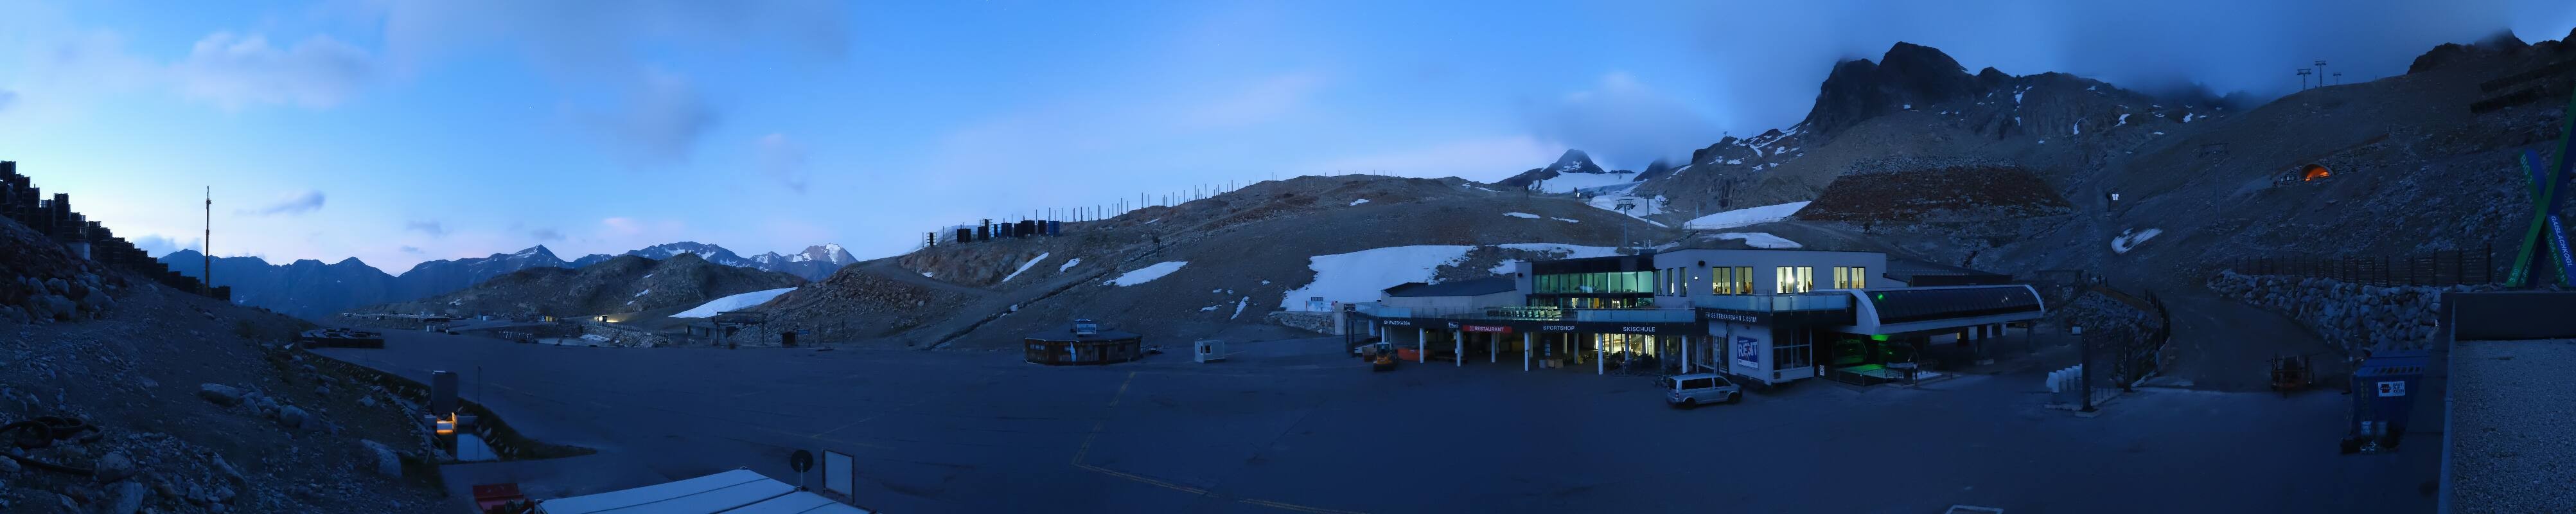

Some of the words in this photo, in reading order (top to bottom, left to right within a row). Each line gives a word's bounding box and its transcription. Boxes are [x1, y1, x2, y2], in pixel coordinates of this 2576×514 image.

[2520, 154, 2530, 175] BIG
[2551, 216, 2573, 267] GAISLACHKOGL
[1738, 342, 1758, 357] RENT
